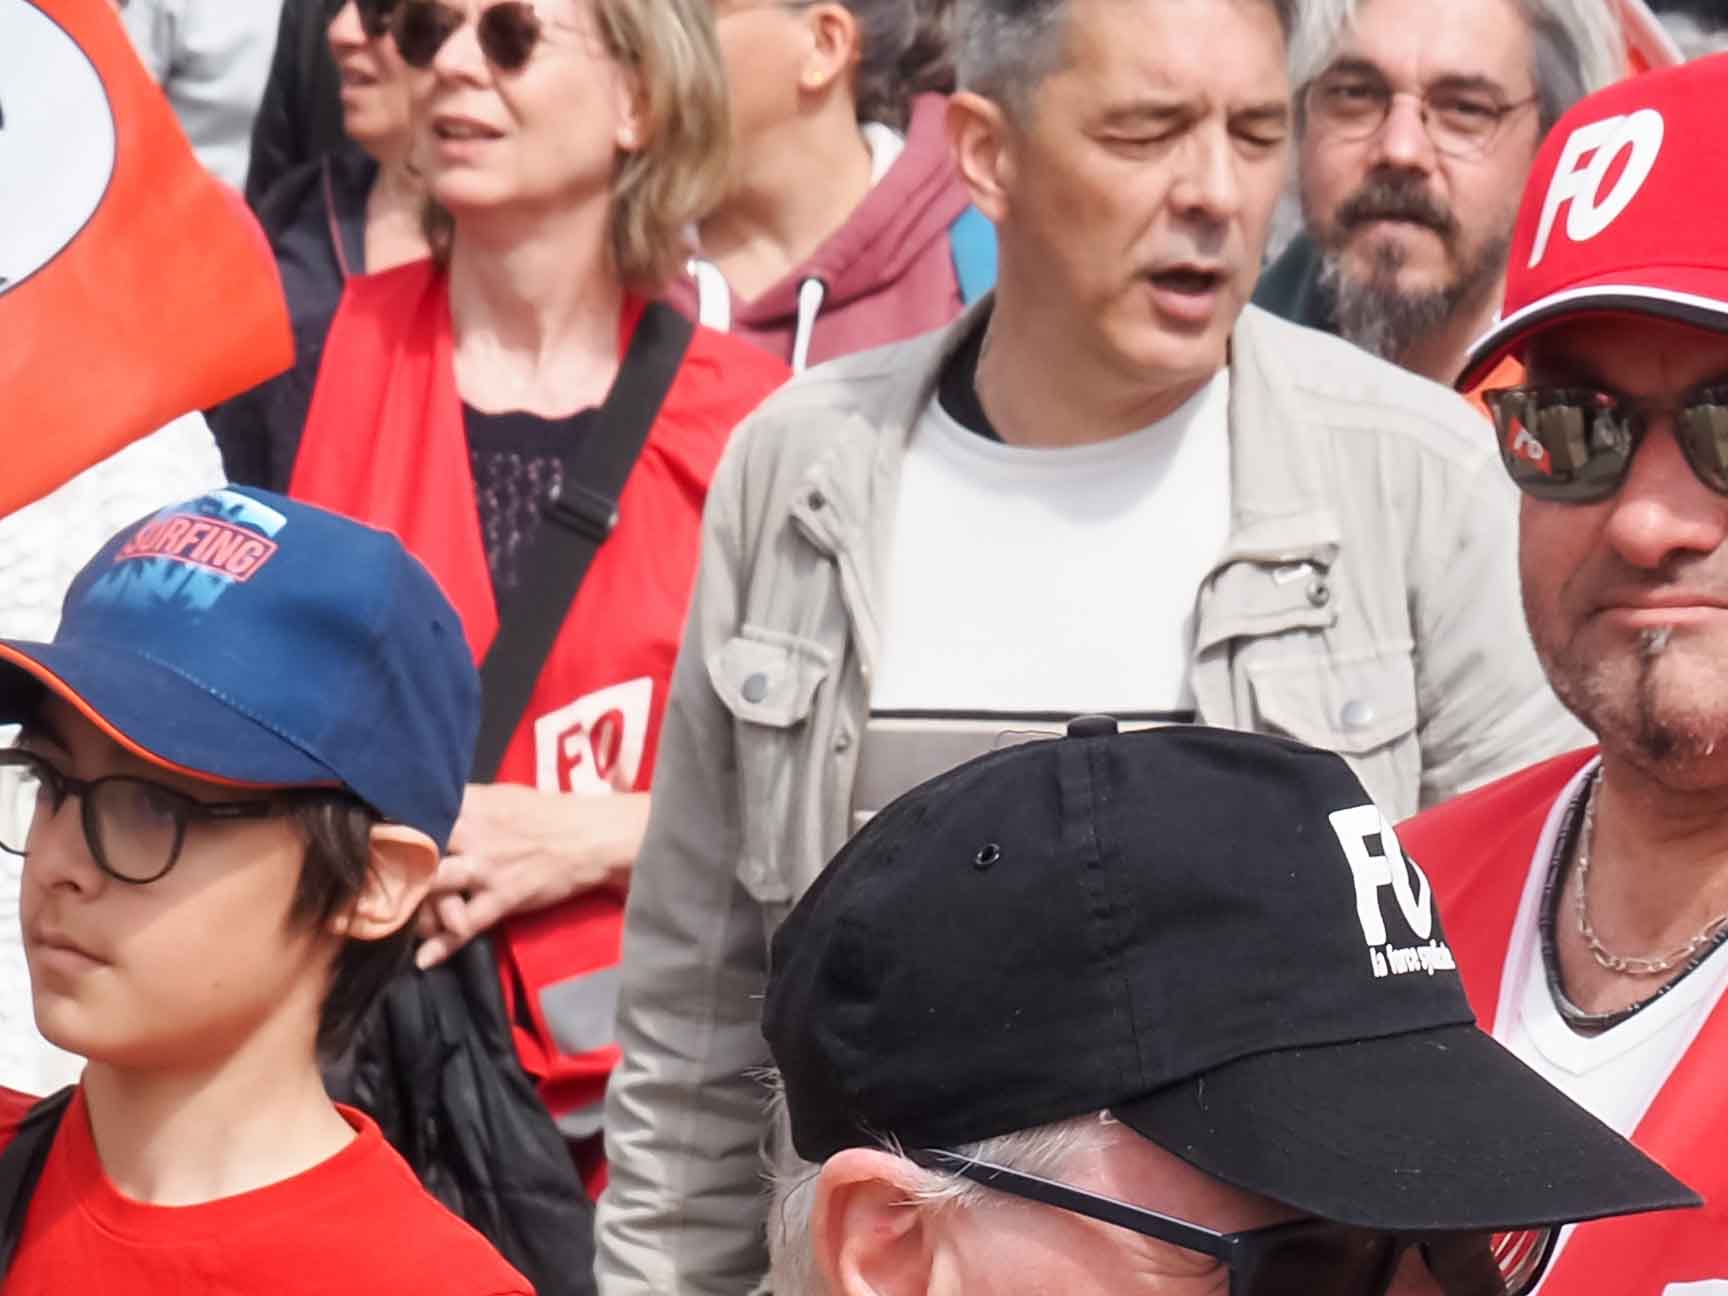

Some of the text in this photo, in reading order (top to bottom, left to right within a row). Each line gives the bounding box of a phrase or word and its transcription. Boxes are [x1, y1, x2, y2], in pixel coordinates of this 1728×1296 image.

[1528, 108, 1664, 269] FO
[556, 707, 624, 793] FO
[1328, 804, 1432, 946] FO
